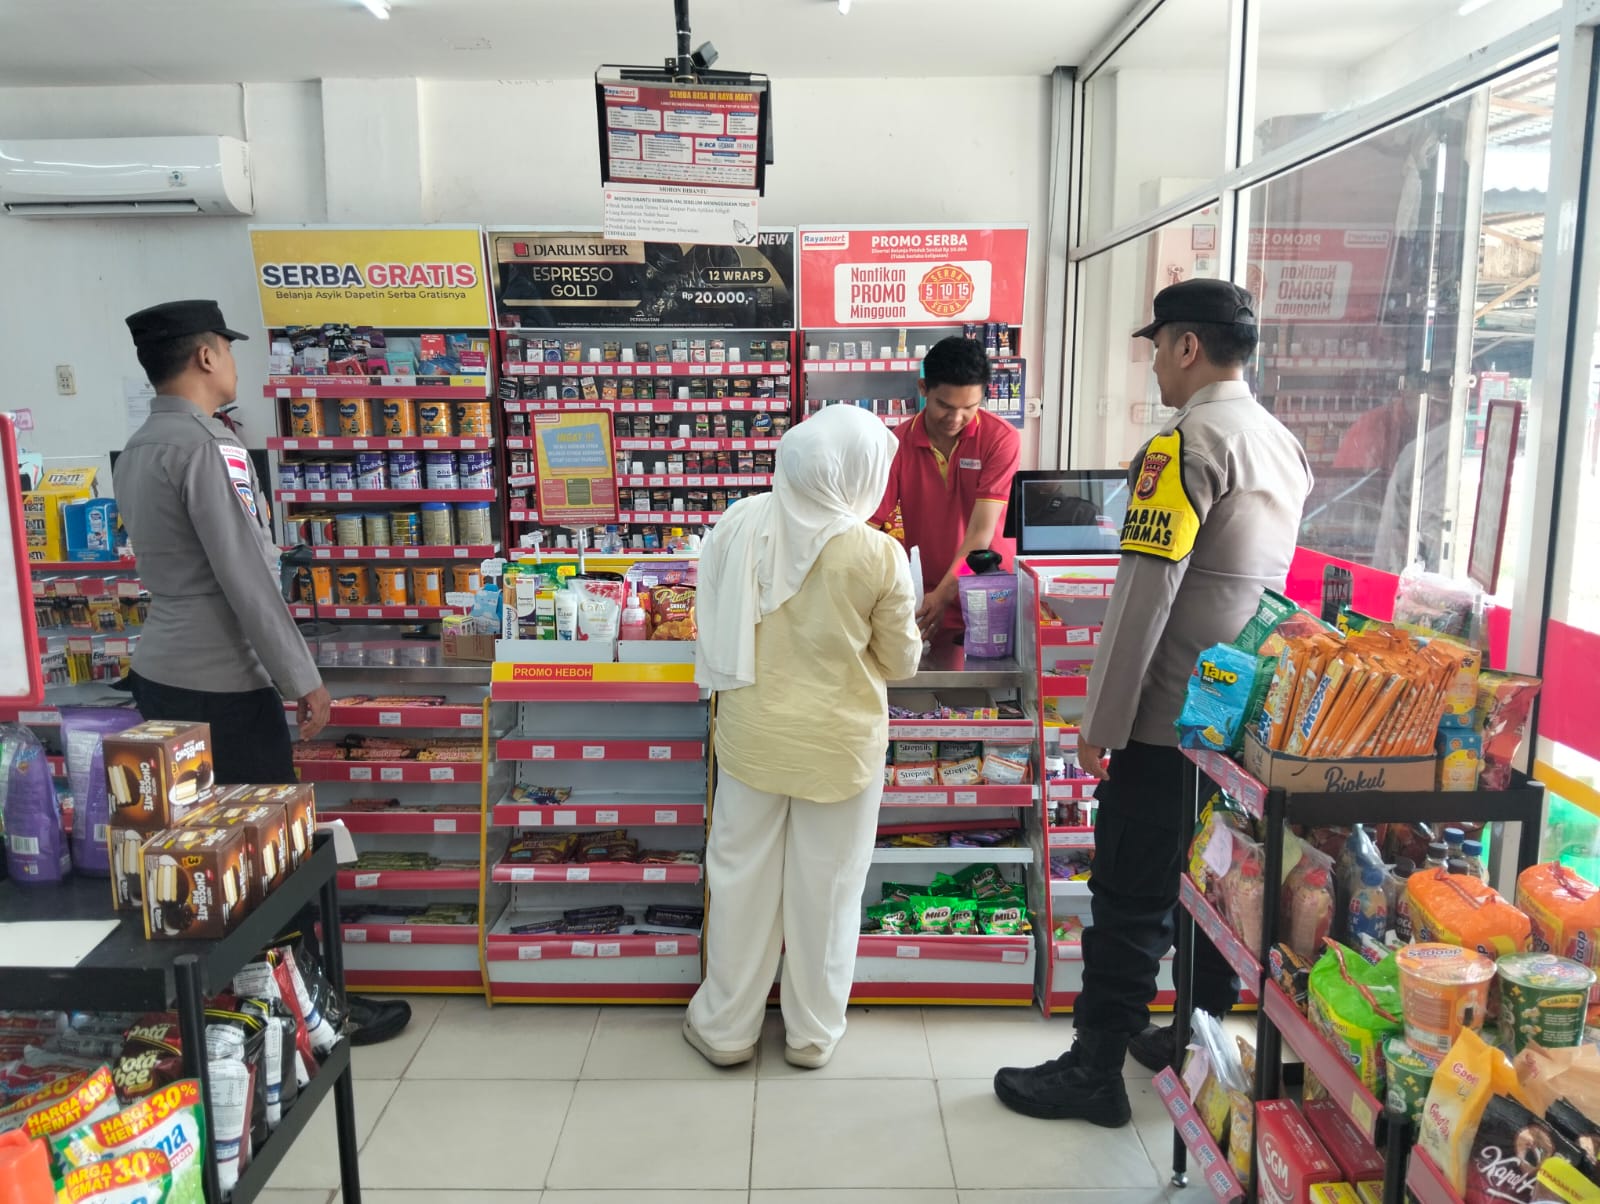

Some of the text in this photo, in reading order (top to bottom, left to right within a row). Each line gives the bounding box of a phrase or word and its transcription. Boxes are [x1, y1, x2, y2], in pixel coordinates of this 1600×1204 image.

[758, 234, 788, 246] NEW
[804, 235, 846, 244] Rayamart
[871, 234, 968, 248] PROMO SERBA
[534, 244, 629, 258] DJARUM SUPER
[262, 263, 477, 287] SERBA GRATIS
[533, 266, 614, 280] ESPRESSO
[708, 270, 764, 281] 12 WRAPS
[851, 268, 906, 282] Nantikan
[276, 290, 466, 300] Belanja Asyik Dapetin Serba Gratisnya
[551, 284, 598, 298] GOLD
[851, 284, 906, 304] PROMO
[926, 283, 969, 296] 5 10 15
[682, 291, 753, 304] Rp 20.000,-
[850, 304, 906, 320] Mingguan
[514, 668, 592, 678] PROMO HEBOH
[1202, 661, 1238, 684] Taro
[900, 743, 932, 752] Strepsils
[900, 770, 930, 779] Strepsils
[944, 763, 976, 778] Strepsils
[140, 762, 154, 811] CHOCOLATE
[194, 872, 208, 920] CHOCOLATE
[925, 911, 948, 920] MILO
[994, 910, 1018, 922] MILO
[27, 1096, 80, 1128] HARGA
[101, 1102, 152, 1136] HARGA
[105, 1114, 155, 1148] HEMAT
[1265, 1141, 1288, 1188] SGM
[71, 1176, 112, 1200] EMAT
